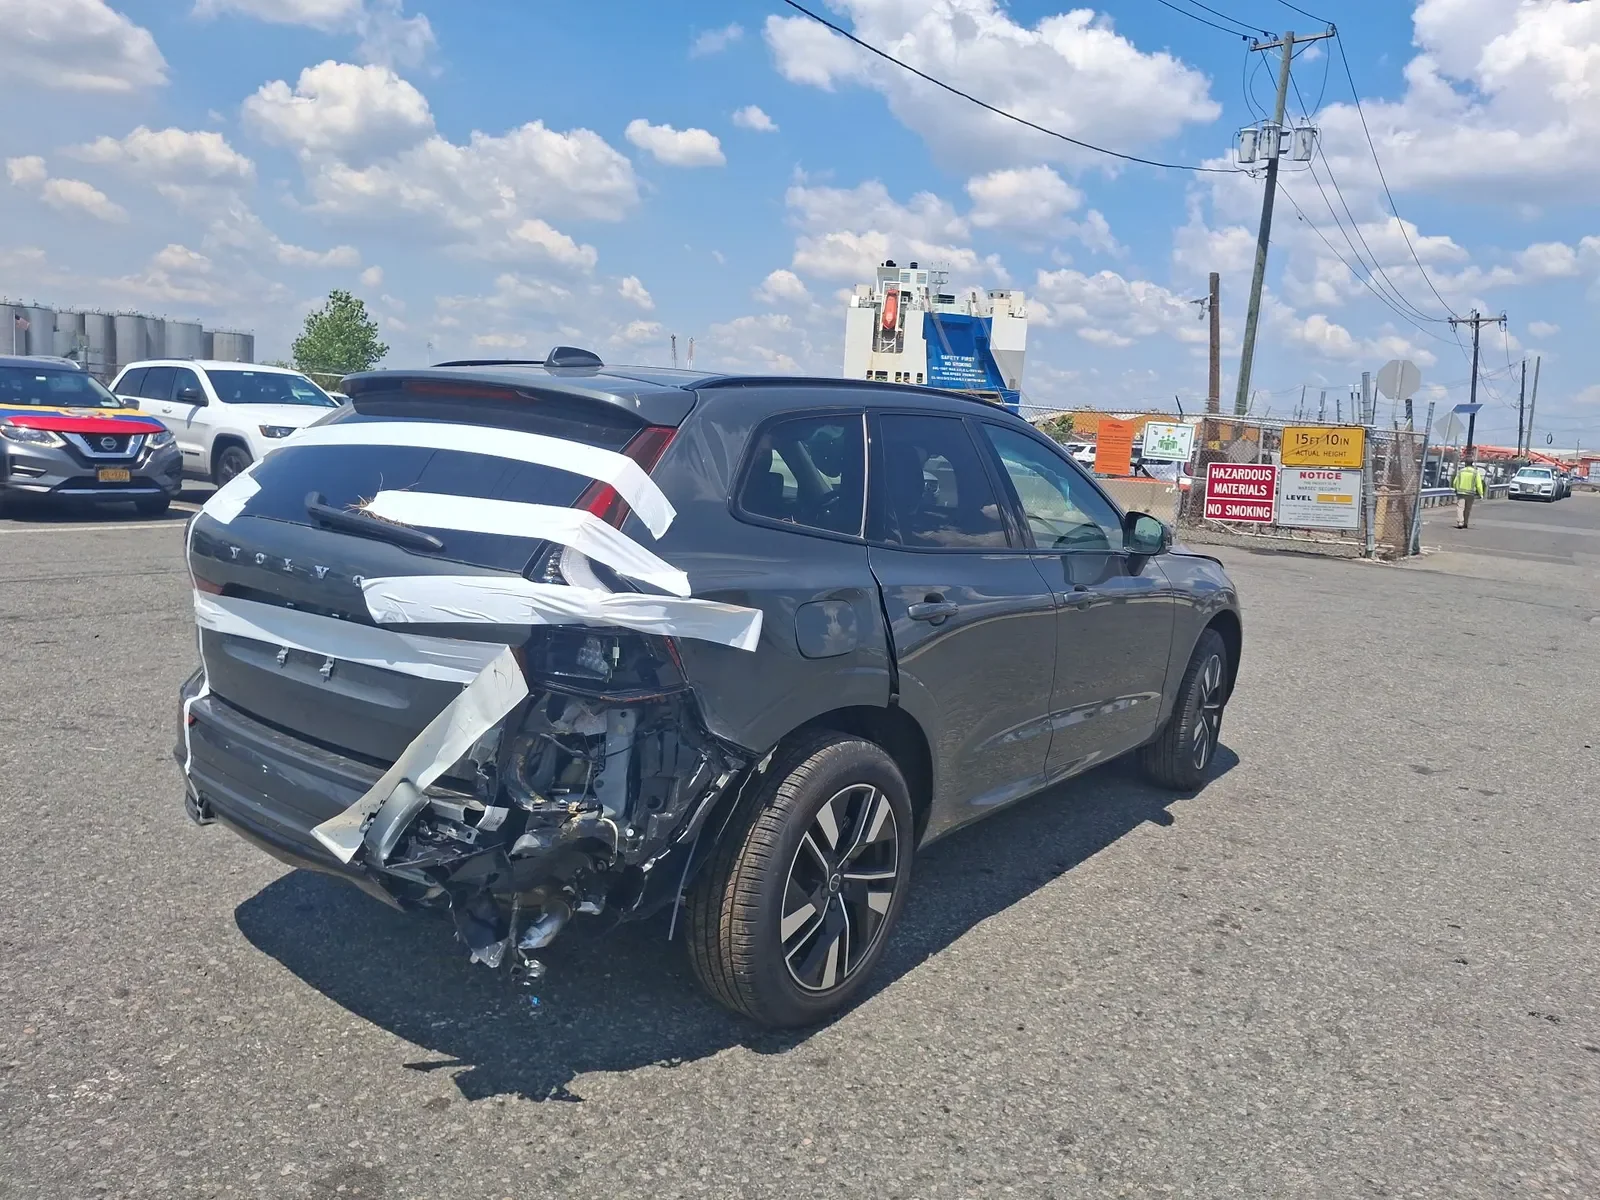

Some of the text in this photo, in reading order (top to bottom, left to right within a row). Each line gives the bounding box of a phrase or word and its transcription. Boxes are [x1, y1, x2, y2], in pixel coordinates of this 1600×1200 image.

[1211, 467, 1272, 481] HAZARDOUS
[1299, 471, 1342, 480] NOTICE
[1213, 483, 1267, 496] MATERIALS
[1285, 494, 1312, 502] LEVEL
[1207, 503, 1222, 516] NO
[1225, 504, 1271, 518] SMOKING
[229, 546, 365, 587] VOLVO
